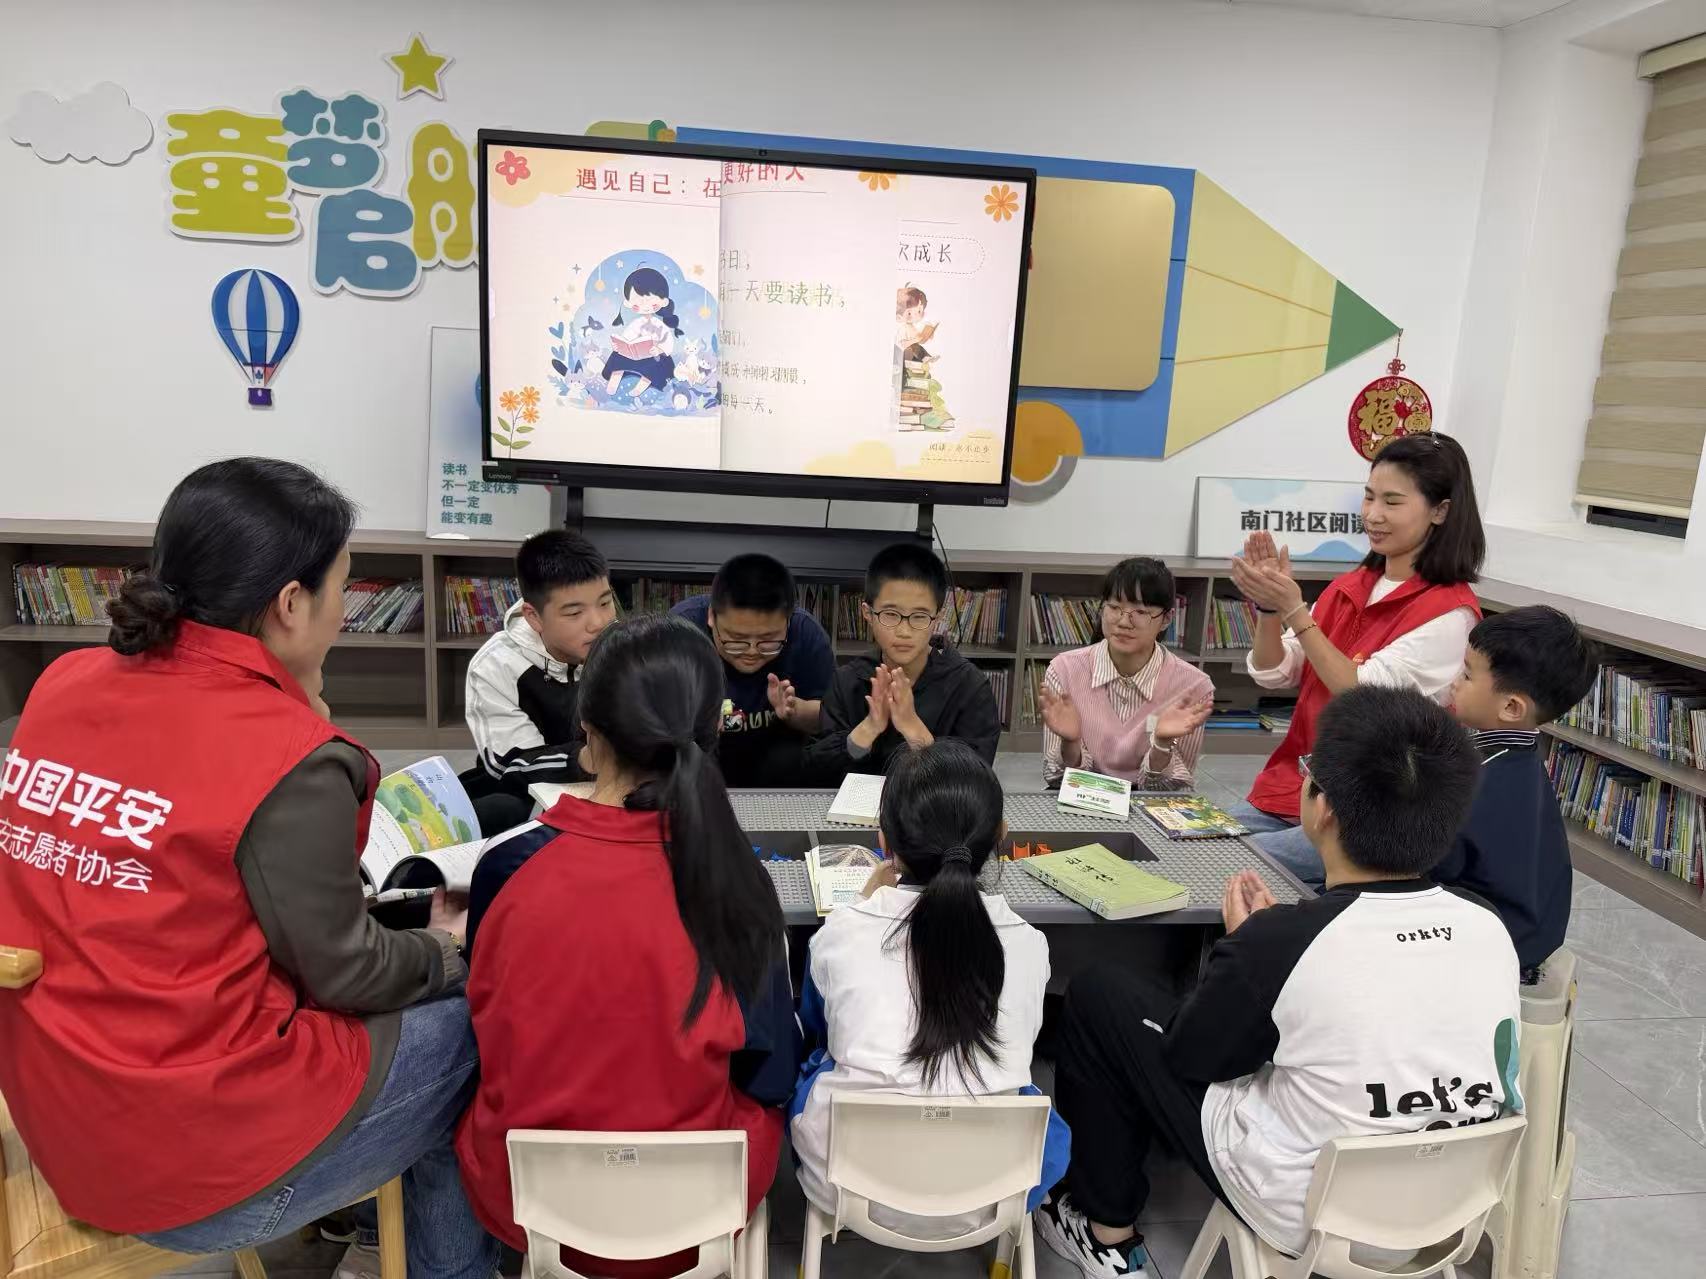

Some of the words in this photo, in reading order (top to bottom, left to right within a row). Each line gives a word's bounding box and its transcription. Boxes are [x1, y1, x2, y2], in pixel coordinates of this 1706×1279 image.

[442, 462, 468, 476] 读书
[441, 479, 520, 494] 不一定变优秀
[441, 496, 480, 509] 但一定
[440, 512, 493, 525] 能变有趣
[0, 749, 173, 850] 中国平安
[1396, 926, 1452, 942] orkty
